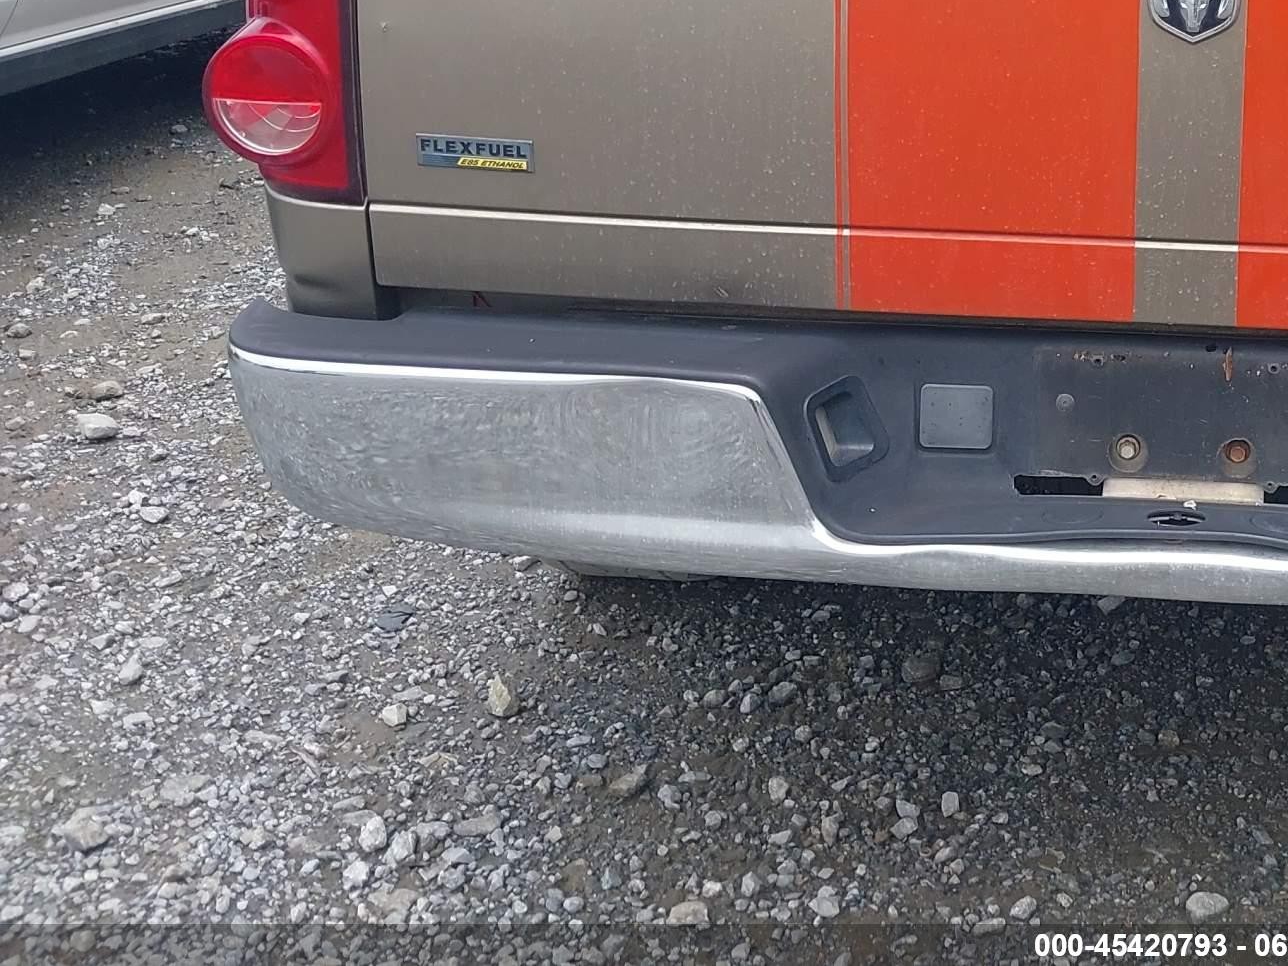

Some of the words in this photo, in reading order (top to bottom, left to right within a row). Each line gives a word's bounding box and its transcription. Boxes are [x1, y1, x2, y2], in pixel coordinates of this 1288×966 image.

[420, 138, 528, 158] FLEXFUEL
[460, 158, 479, 167] E85
[480, 159, 525, 170] ETHANOL
